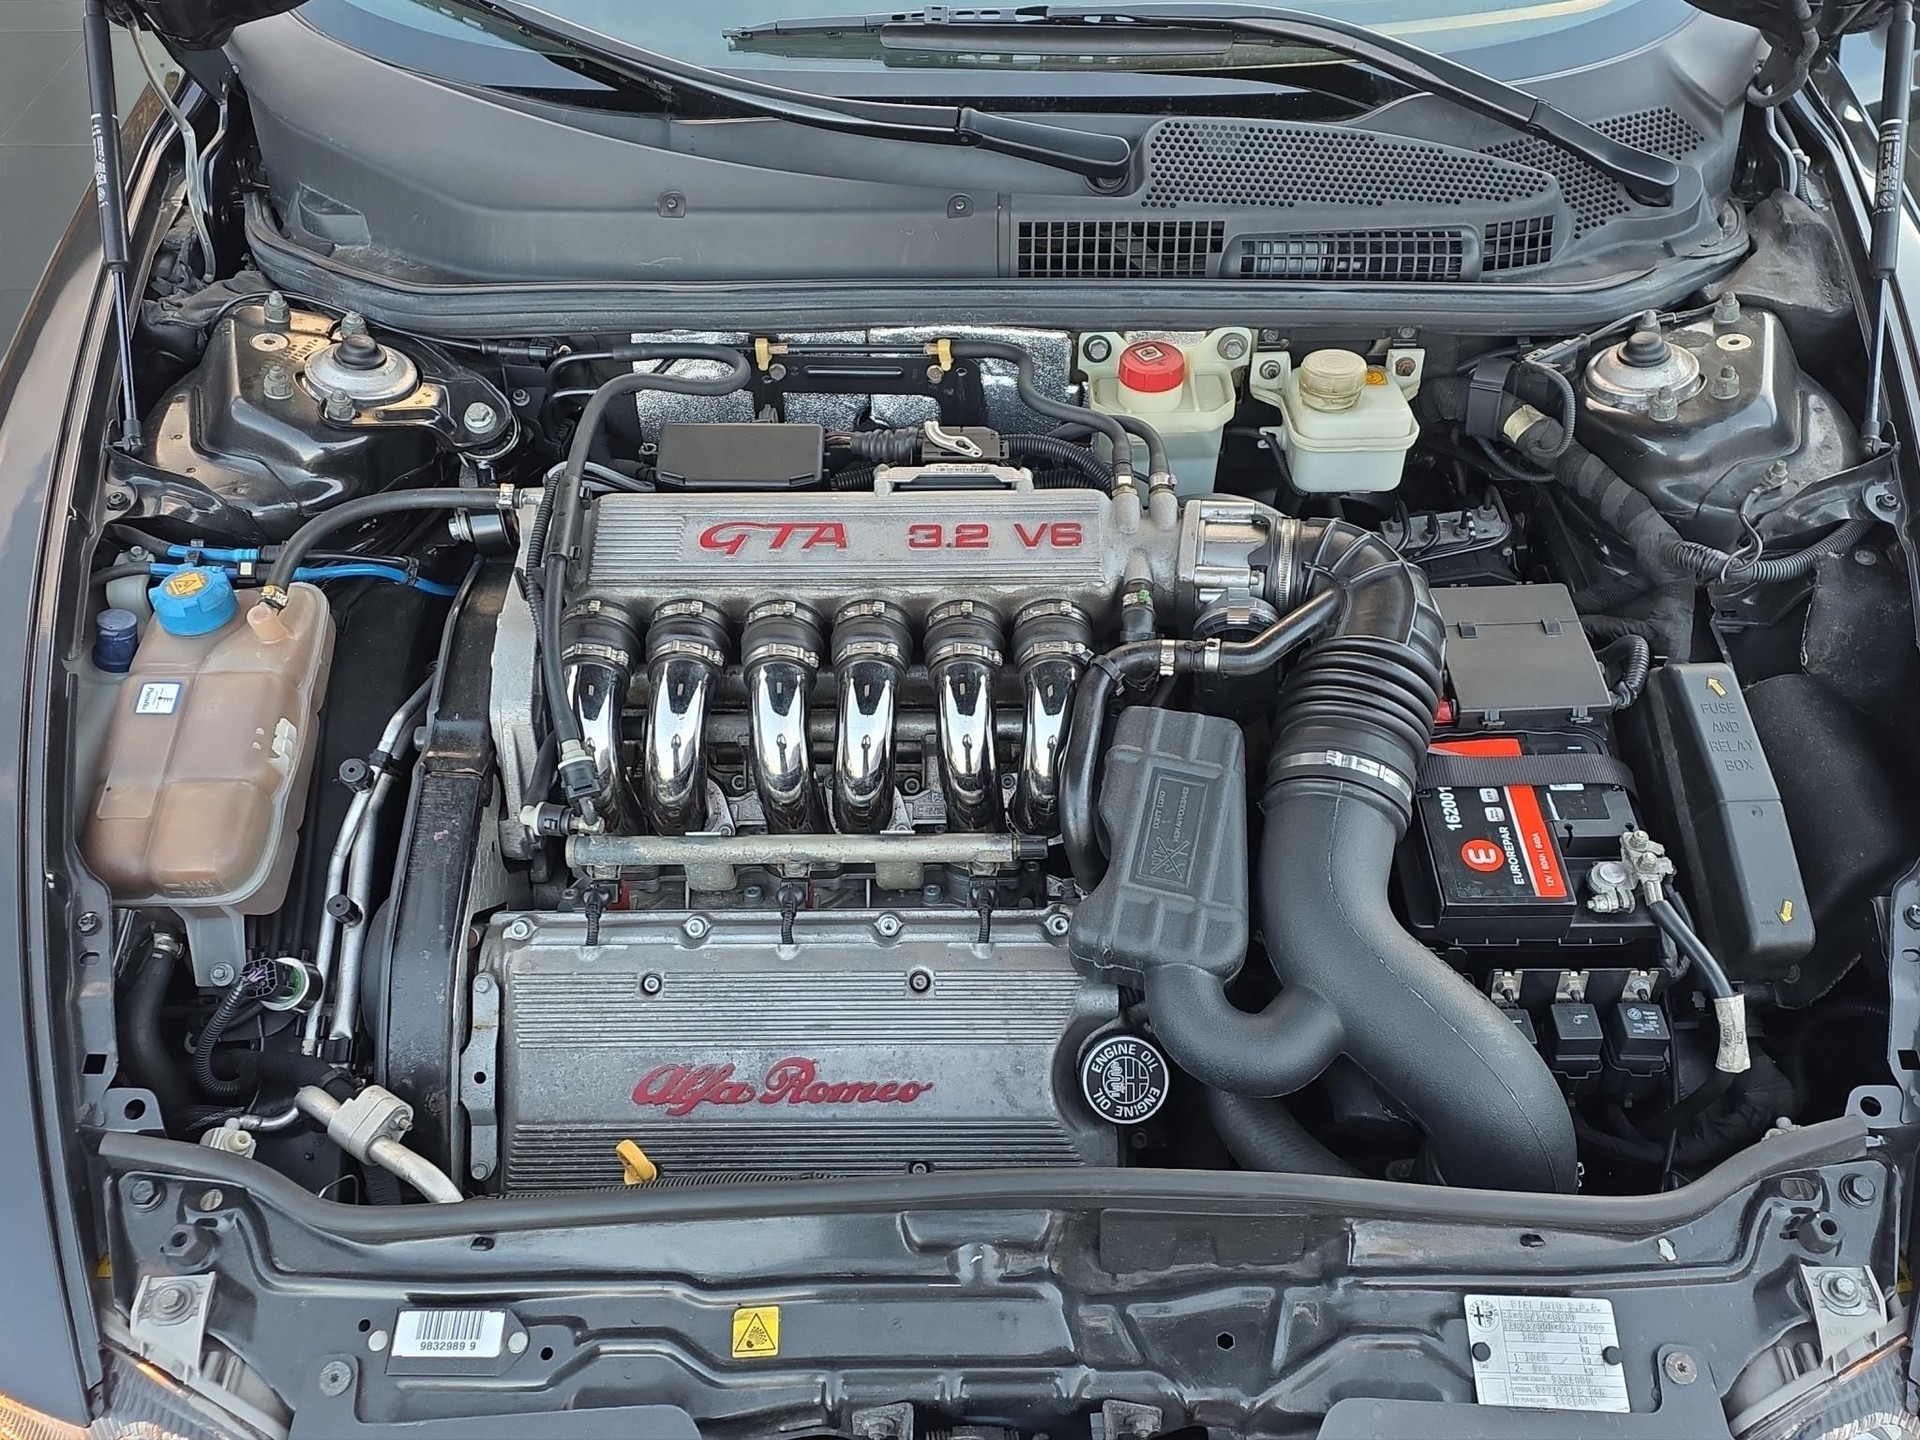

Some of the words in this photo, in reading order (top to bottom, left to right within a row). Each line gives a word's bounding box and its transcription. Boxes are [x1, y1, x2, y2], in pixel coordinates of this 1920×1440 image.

[700, 521, 848, 555] GTA
[908, 523, 990, 550] 3.2
[1013, 522, 1083, 549] V6
[1700, 702, 1737, 714] FUSE
[1712, 721, 1739, 733] AND
[1708, 740, 1753, 752] RELAY
[1724, 759, 1755, 771] BOX
[1437, 786, 1462, 831] 162001
[1499, 826, 1525, 885] EUROREPAR
[1091, 1043, 1137, 1073] ENGINE
[1140, 1050, 1159, 1073] OIL
[631, 1062, 756, 1116] Alfa
[758, 1056, 934, 1105] Romeo
[1092, 1088, 1112, 1111] OIL
[1114, 1087, 1160, 1117] ENGINE
[419, 1341, 466, 1351] 9832989
[469, 1341, 476, 1351] 9
